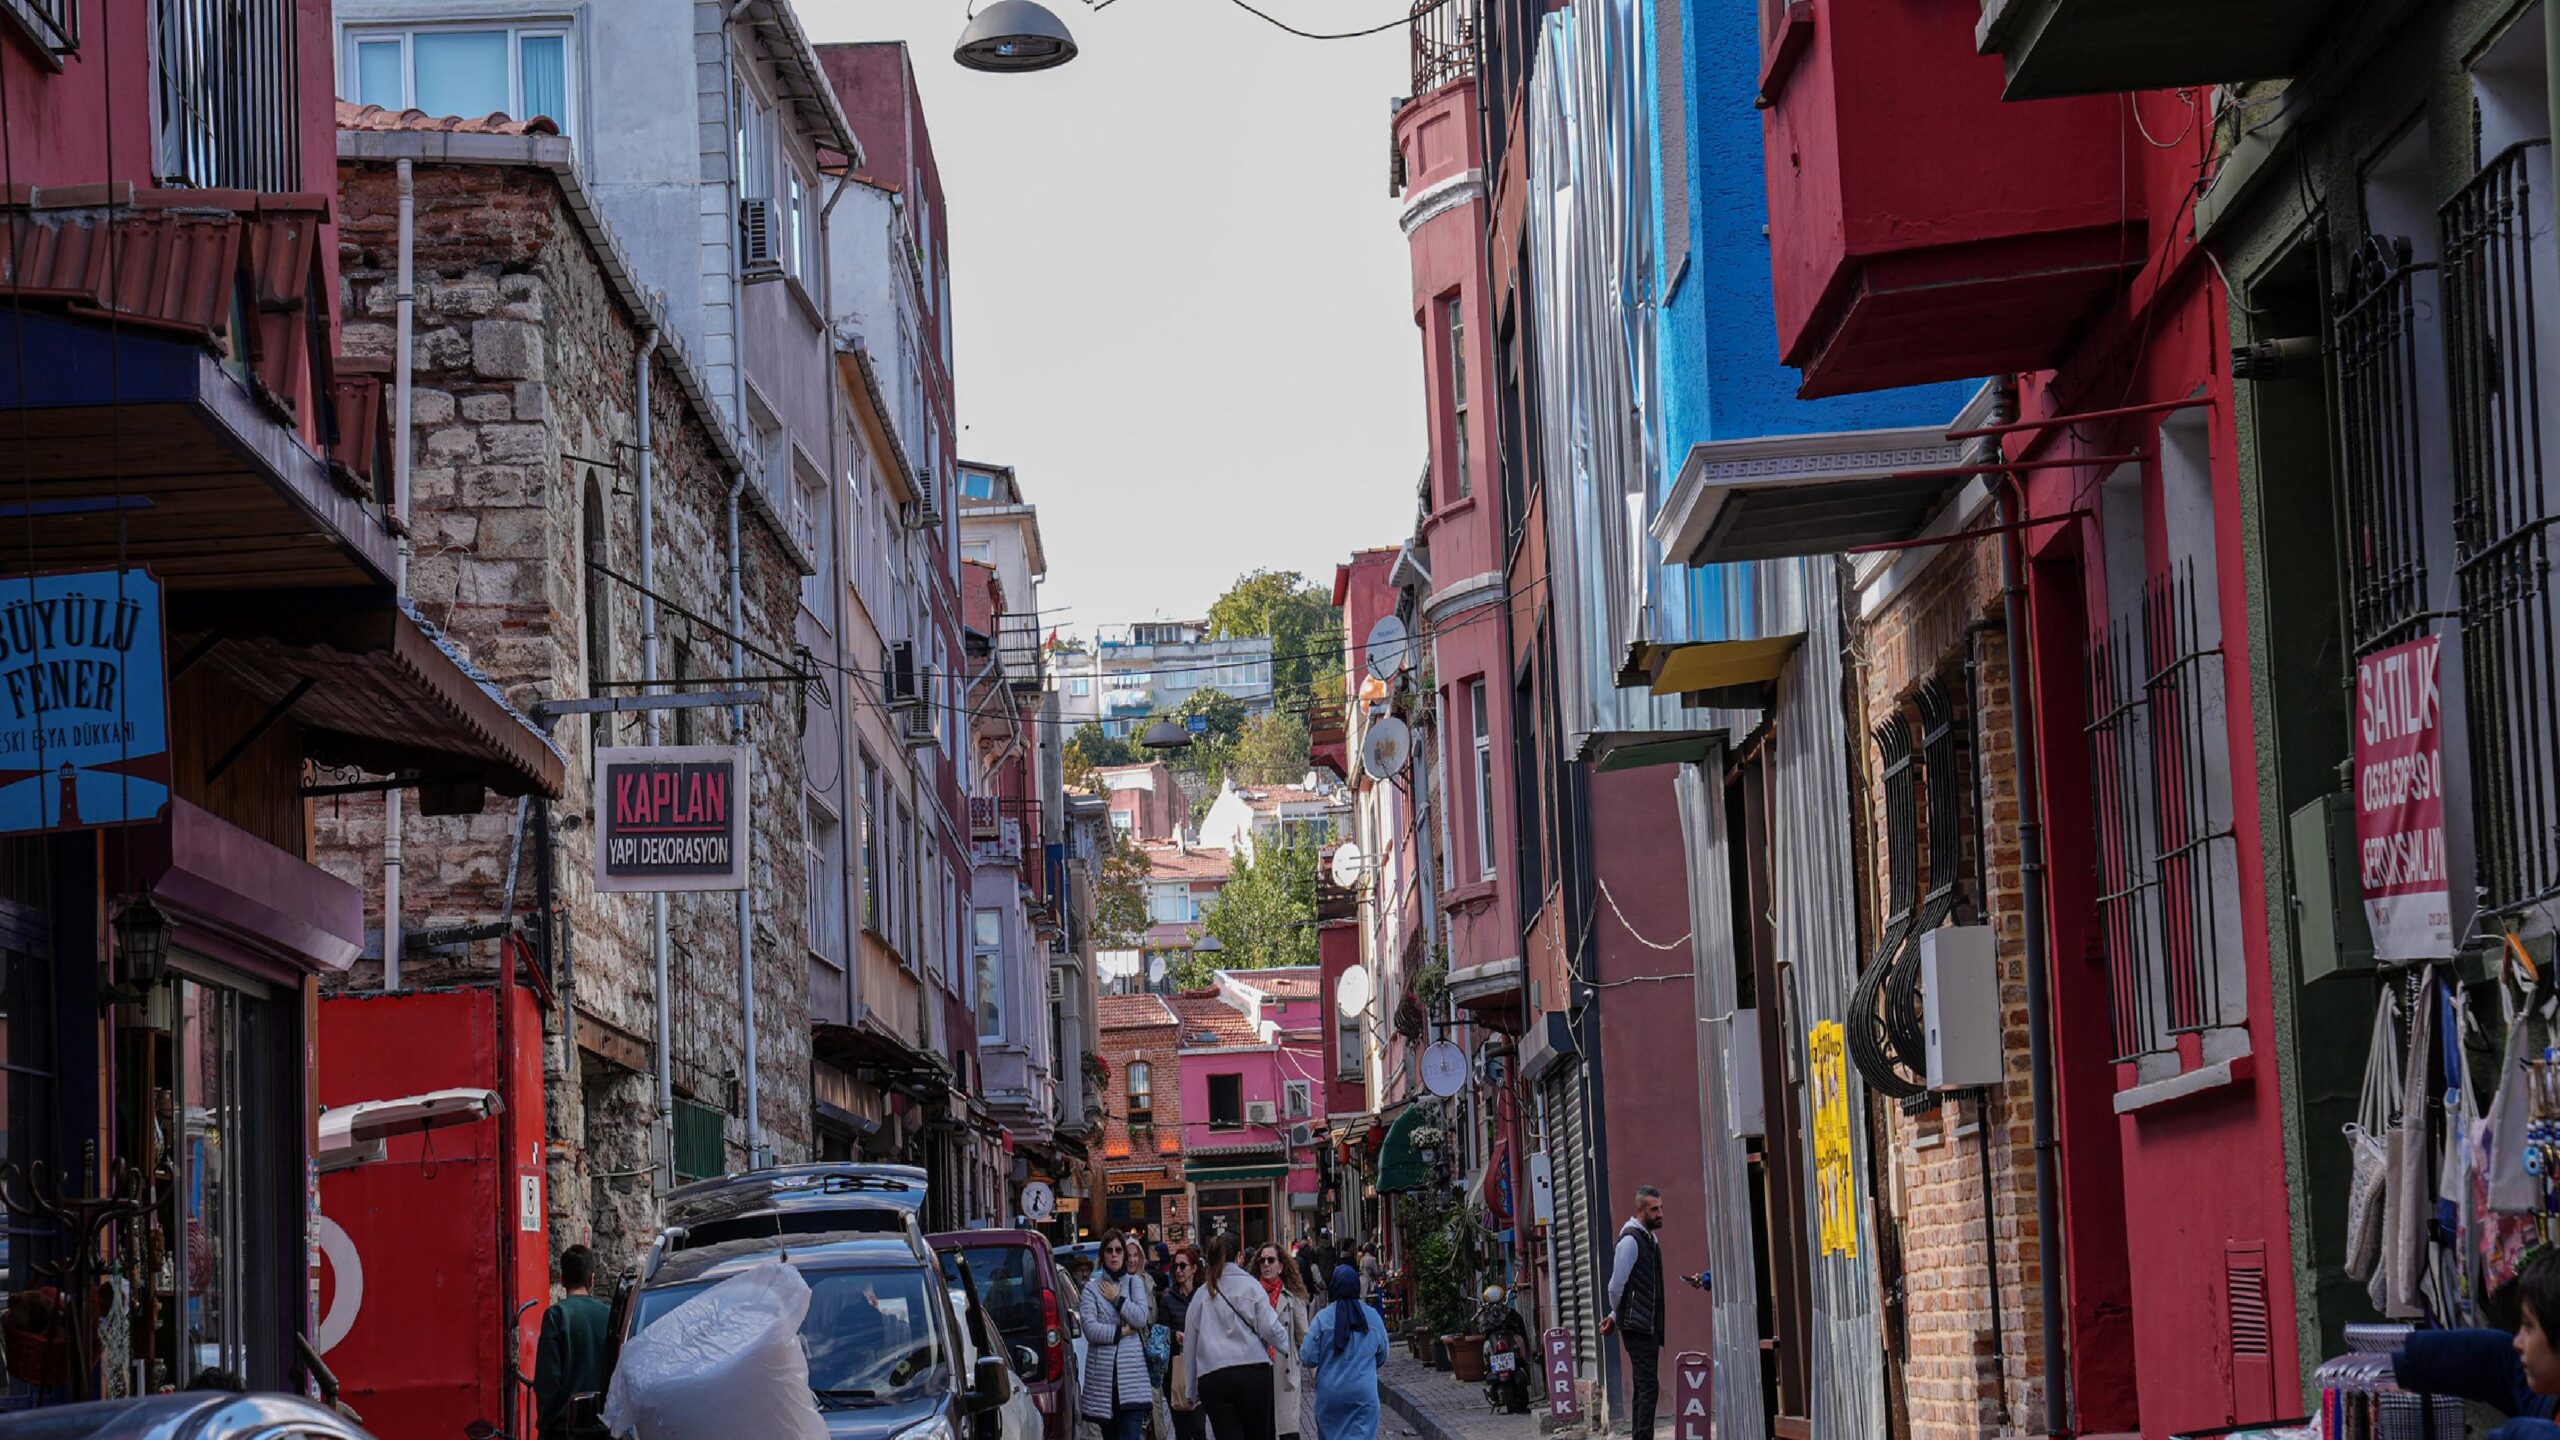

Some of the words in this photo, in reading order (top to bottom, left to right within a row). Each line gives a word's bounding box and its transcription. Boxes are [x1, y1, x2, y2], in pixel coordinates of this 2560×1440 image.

[3, 659, 117, 719] FENER
[2361, 643, 2439, 746] SATILIK
[616, 772, 725, 824] KAPLAN
[2363, 760, 2390, 812] 0533
[609, 838, 637, 865] YAPI
[641, 837, 728, 864] DEKORASYON
[1552, 1341, 1573, 1414] PARK
[1684, 1371, 1706, 1440] VAL
